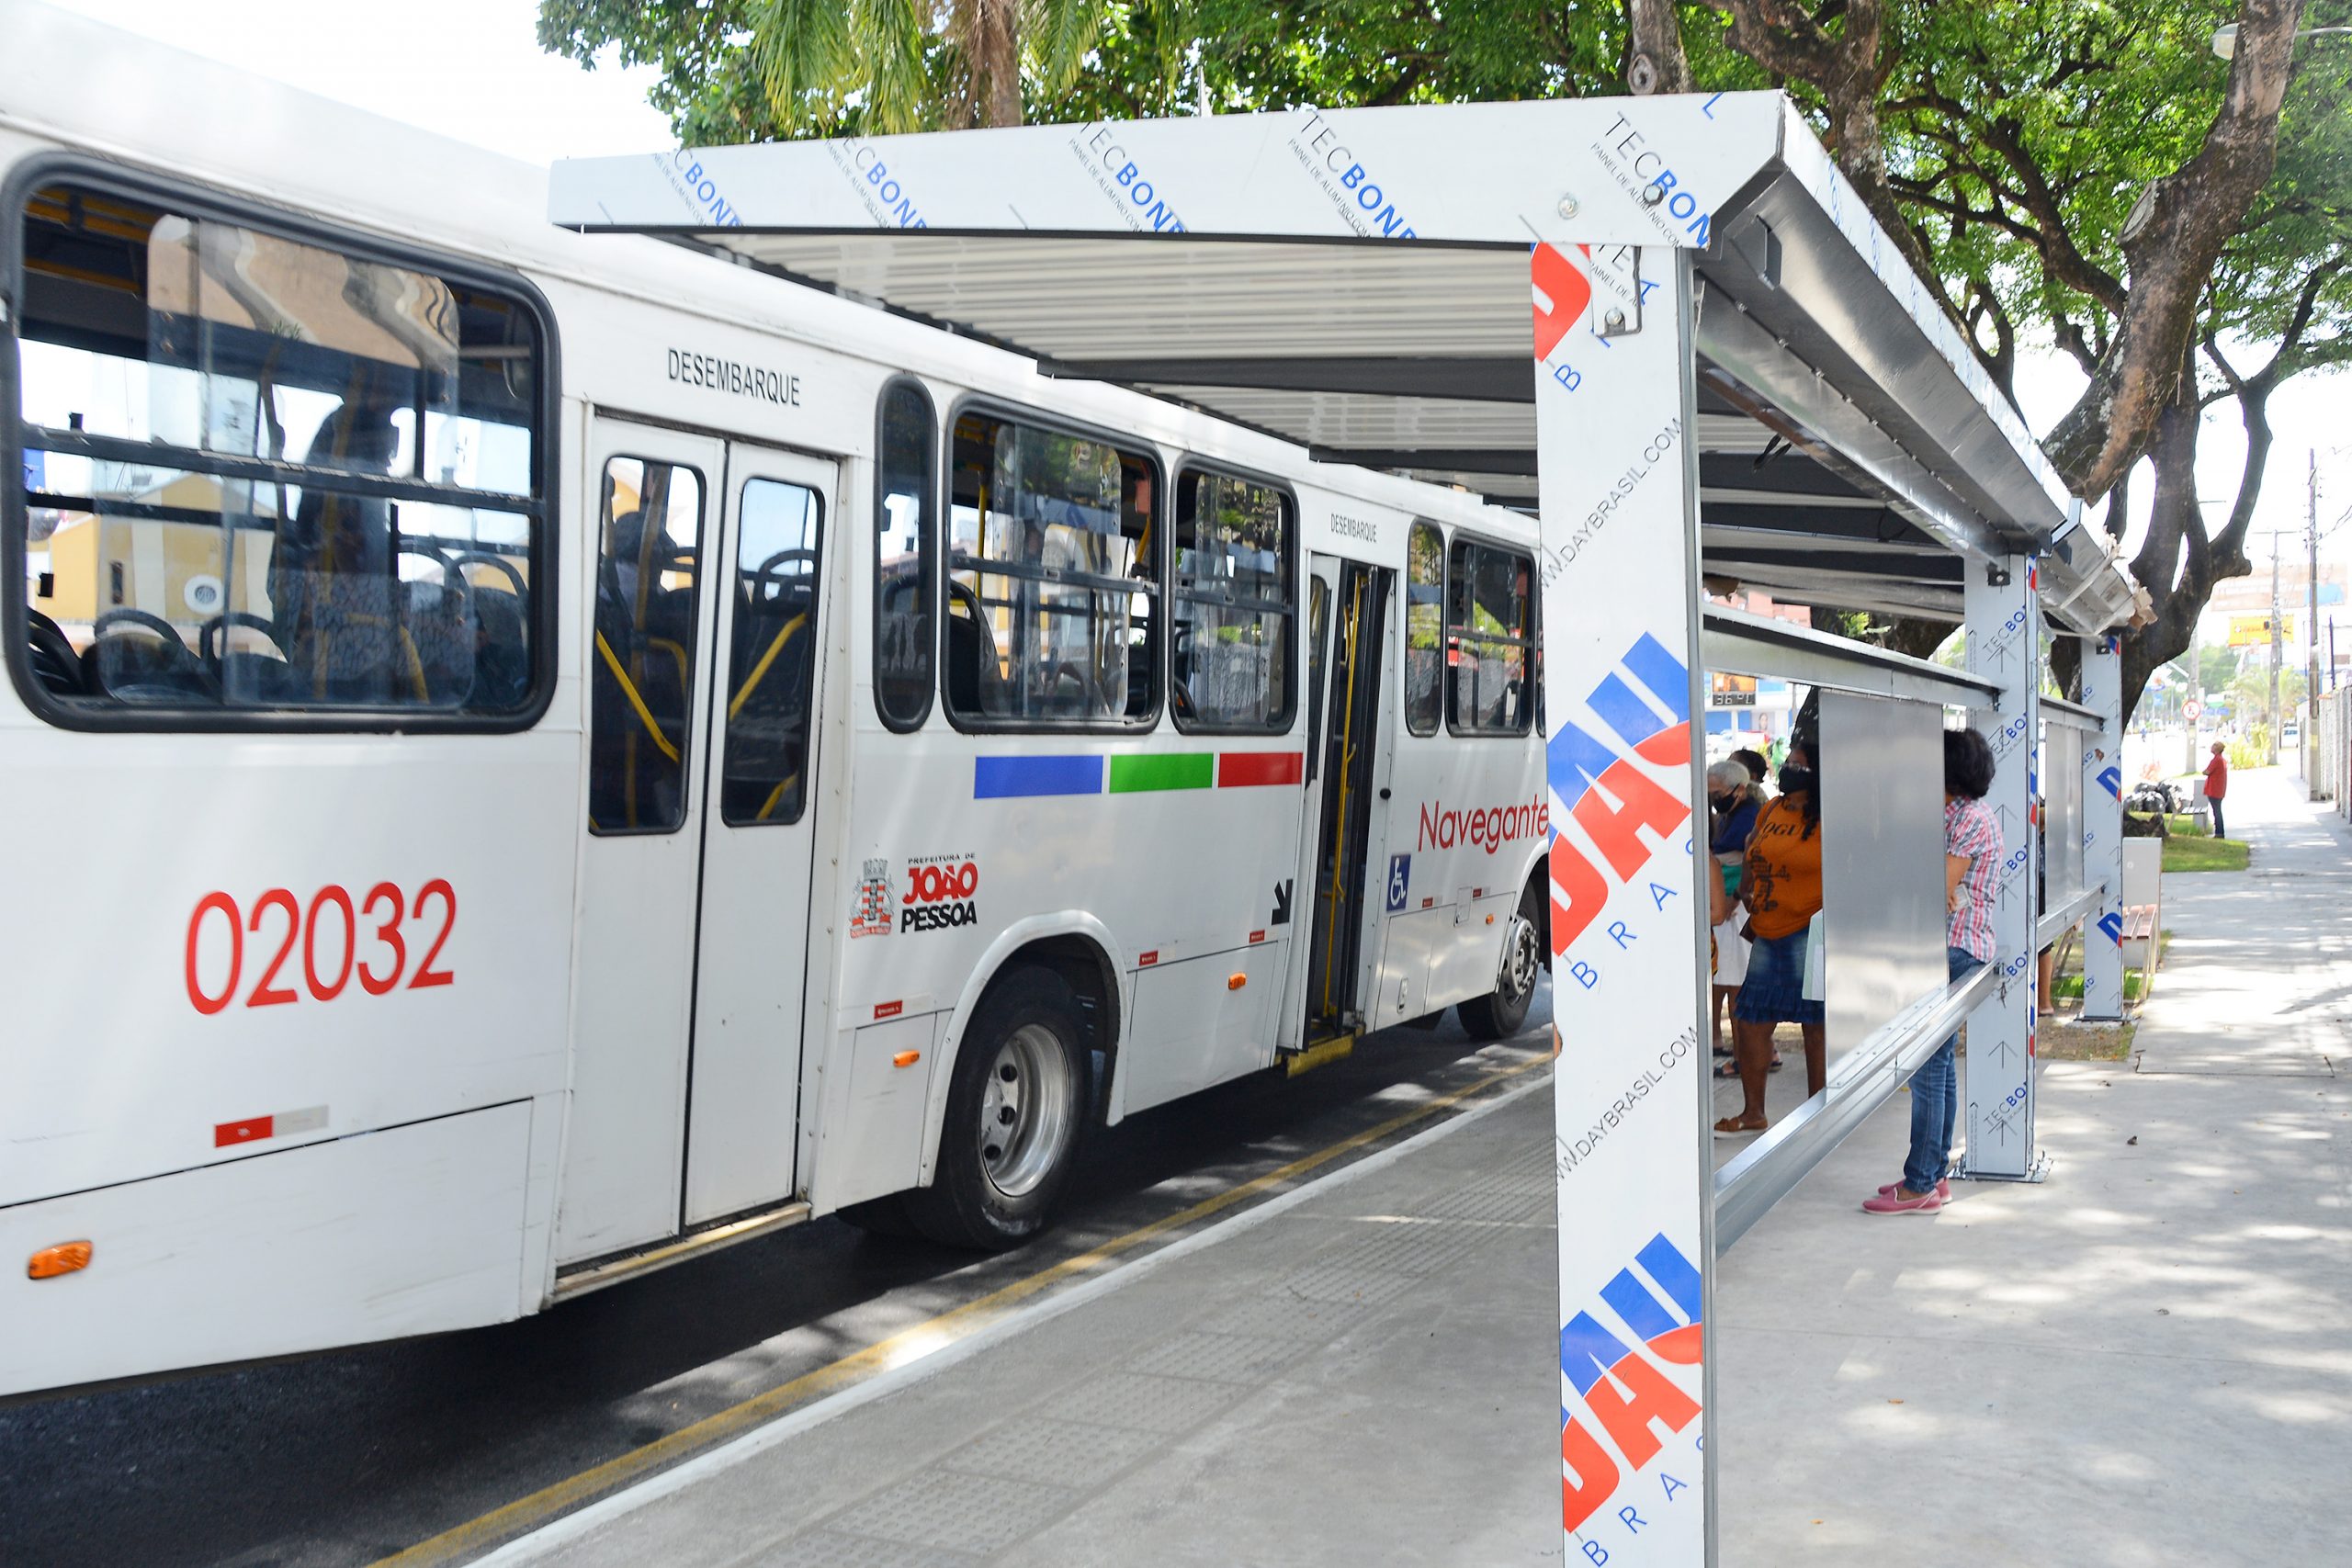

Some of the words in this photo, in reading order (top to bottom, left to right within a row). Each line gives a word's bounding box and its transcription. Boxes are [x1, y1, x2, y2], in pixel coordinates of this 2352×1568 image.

[668, 348, 800, 407] DESEMBARQUE
[1330, 513, 1376, 542] DESEMBARQUE
[1983, 604, 2026, 653] TECBO
[1419, 794, 1548, 854] Navegante
[908, 854, 960, 864] PREFEITURA
[902, 862, 978, 905] JOÃO
[900, 900, 978, 933] PESSOA
[185, 878, 457, 1015] 02032
[1984, 1081, 2027, 1126] TECBO
